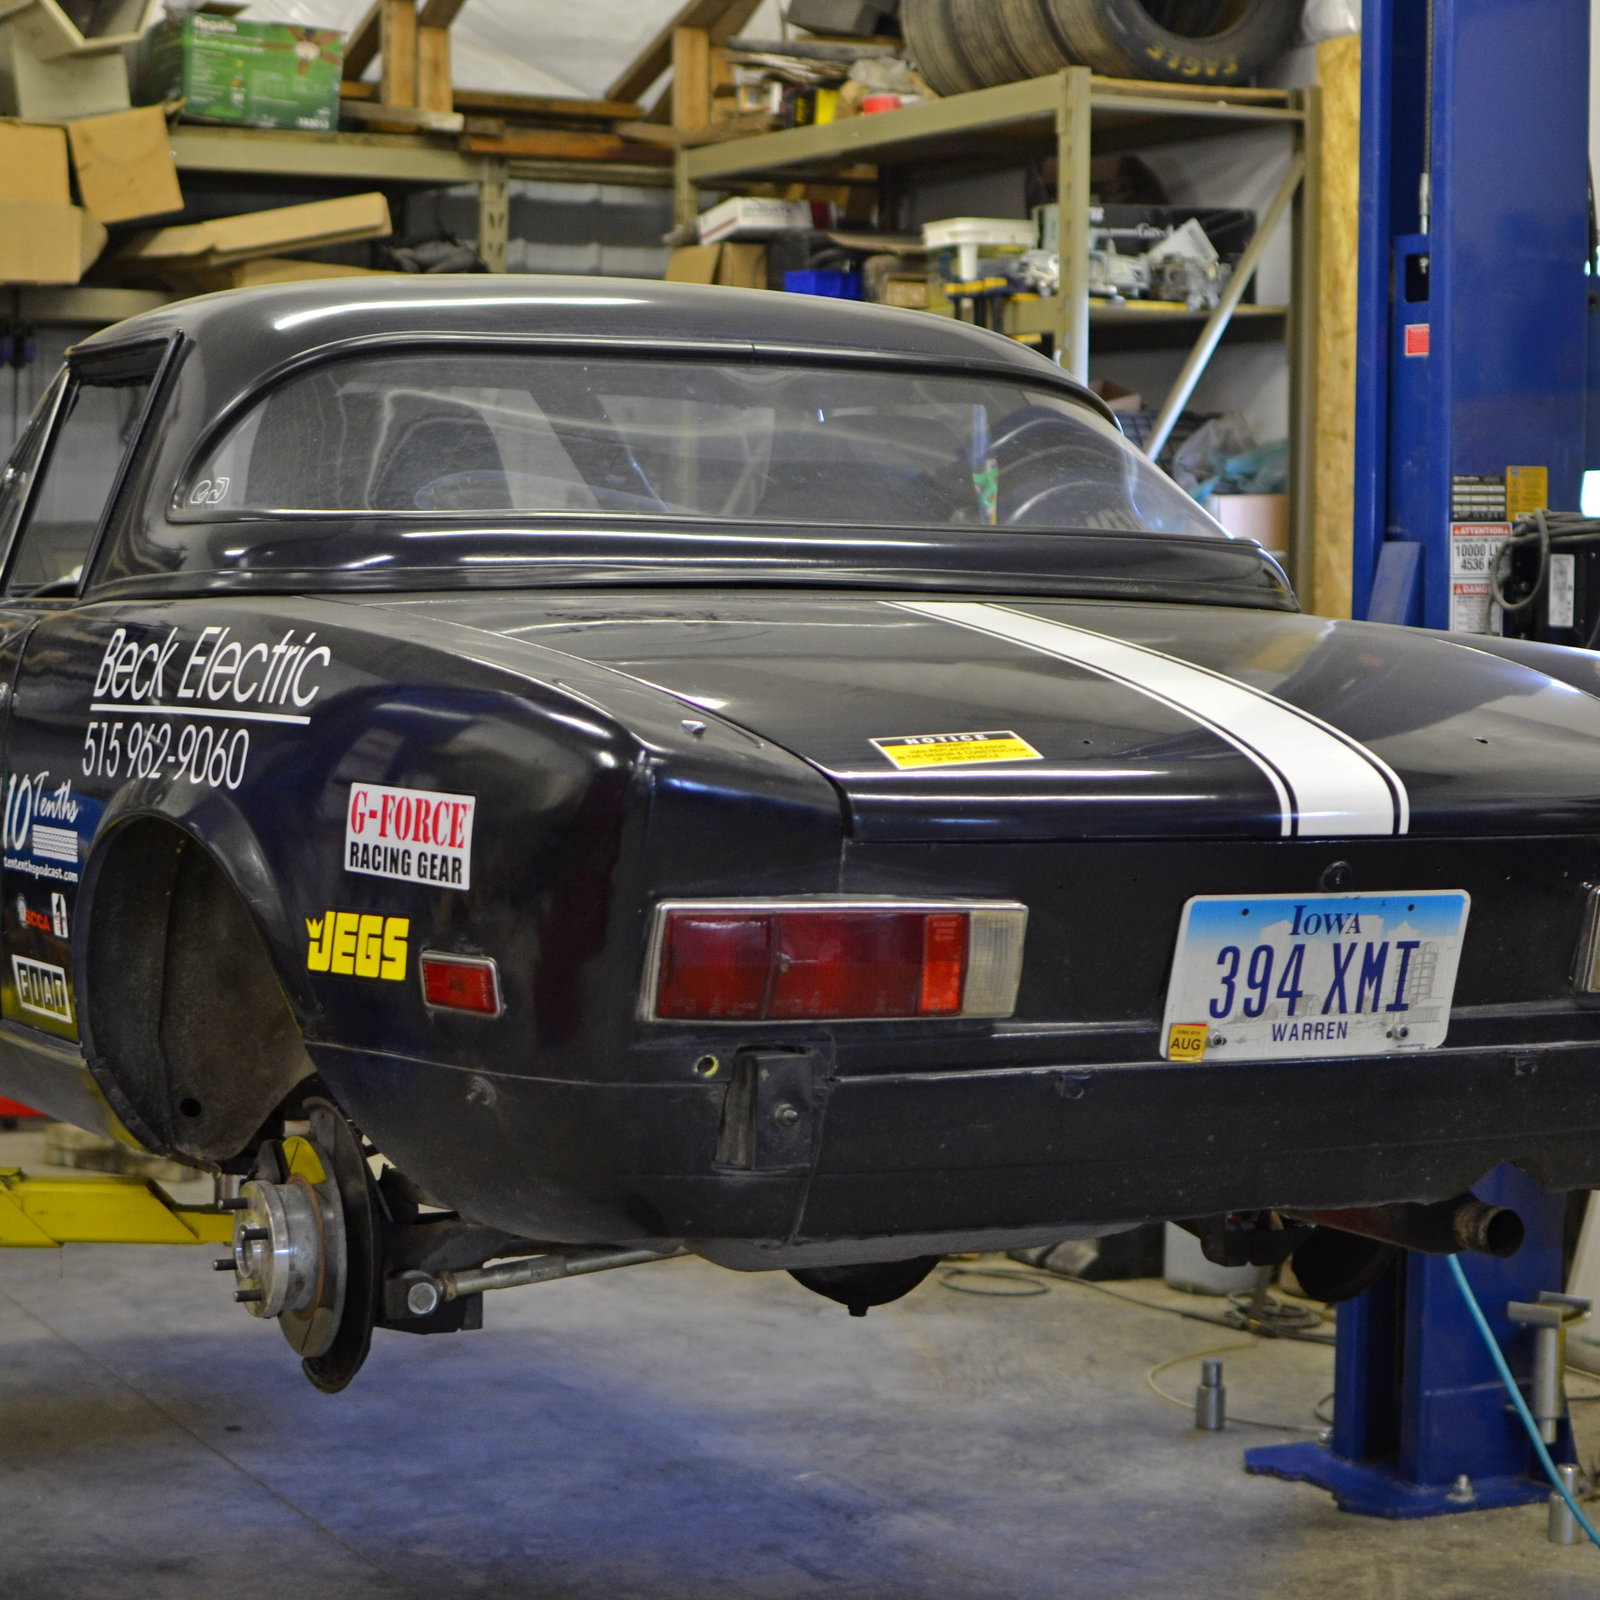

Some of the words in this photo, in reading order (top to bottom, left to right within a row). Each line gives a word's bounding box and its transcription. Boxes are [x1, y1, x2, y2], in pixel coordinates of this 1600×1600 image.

[1456, 544, 1486, 557] 10000
[1460, 527, 1504, 535] ATTENTION
[1461, 557, 1485, 570] 4536
[94, 627, 178, 699] Beck
[177, 626, 332, 707] Electric
[82, 721, 122, 777] 515
[126, 723, 250, 790] 962-9060
[906, 734, 988, 745] NOTICE
[3, 773, 33, 852] 10
[34, 770, 79, 823] Tenths
[351, 790, 469, 849] G-FORCE
[350, 841, 412, 877] RACING
[417, 851, 463, 884] GEAR
[26, 908, 52, 932] SCCA
[306, 911, 410, 981] JEGS
[20, 968, 64, 1008] FIAT
[1209, 943, 1306, 1019] 394
[1321, 940, 1421, 1015] XMI
[1170, 1037, 1202, 1051] AUG
[1272, 1021, 1349, 1043] WARREN
